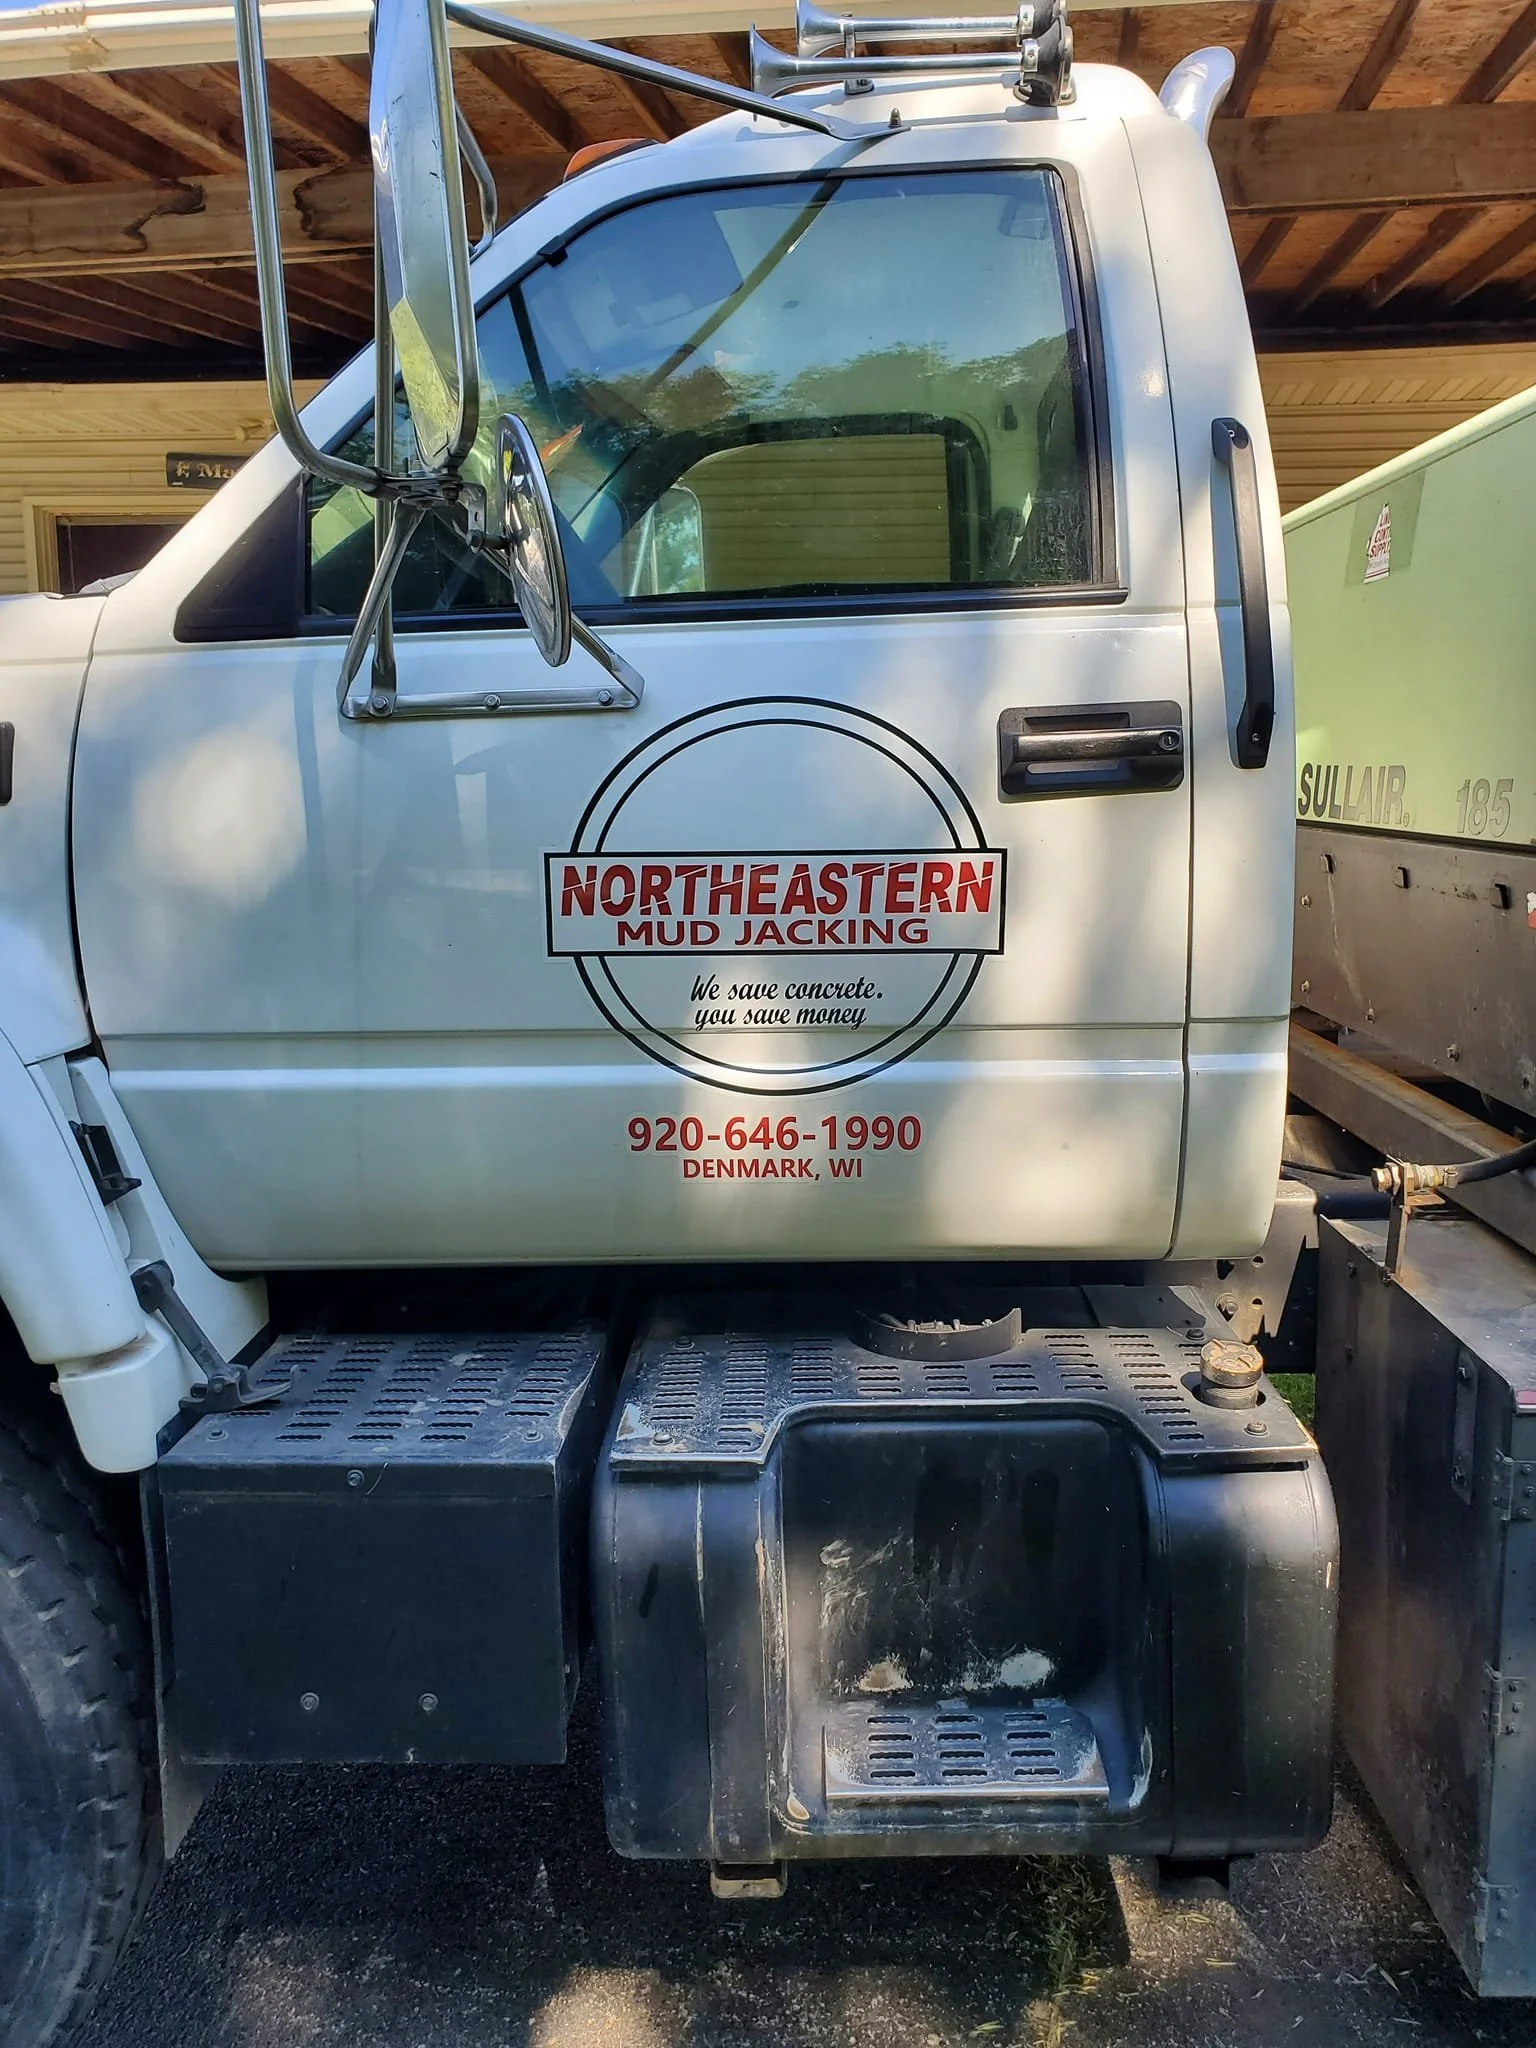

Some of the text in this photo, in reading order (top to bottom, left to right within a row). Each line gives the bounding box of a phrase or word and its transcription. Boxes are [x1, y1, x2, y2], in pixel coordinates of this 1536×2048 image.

[197, 463, 236, 479] Ma
[1456, 777, 1514, 837] 185
[561, 861, 994, 917] NORTHEASTERN
[617, 918, 930, 946] MUD JACKING
[691, 974, 884, 1001] We save concrete.
[695, 1006, 867, 1031] you save money
[628, 1115, 921, 1151] 920-646-1990
[682, 1158, 863, 1180] DENMARK, WI
